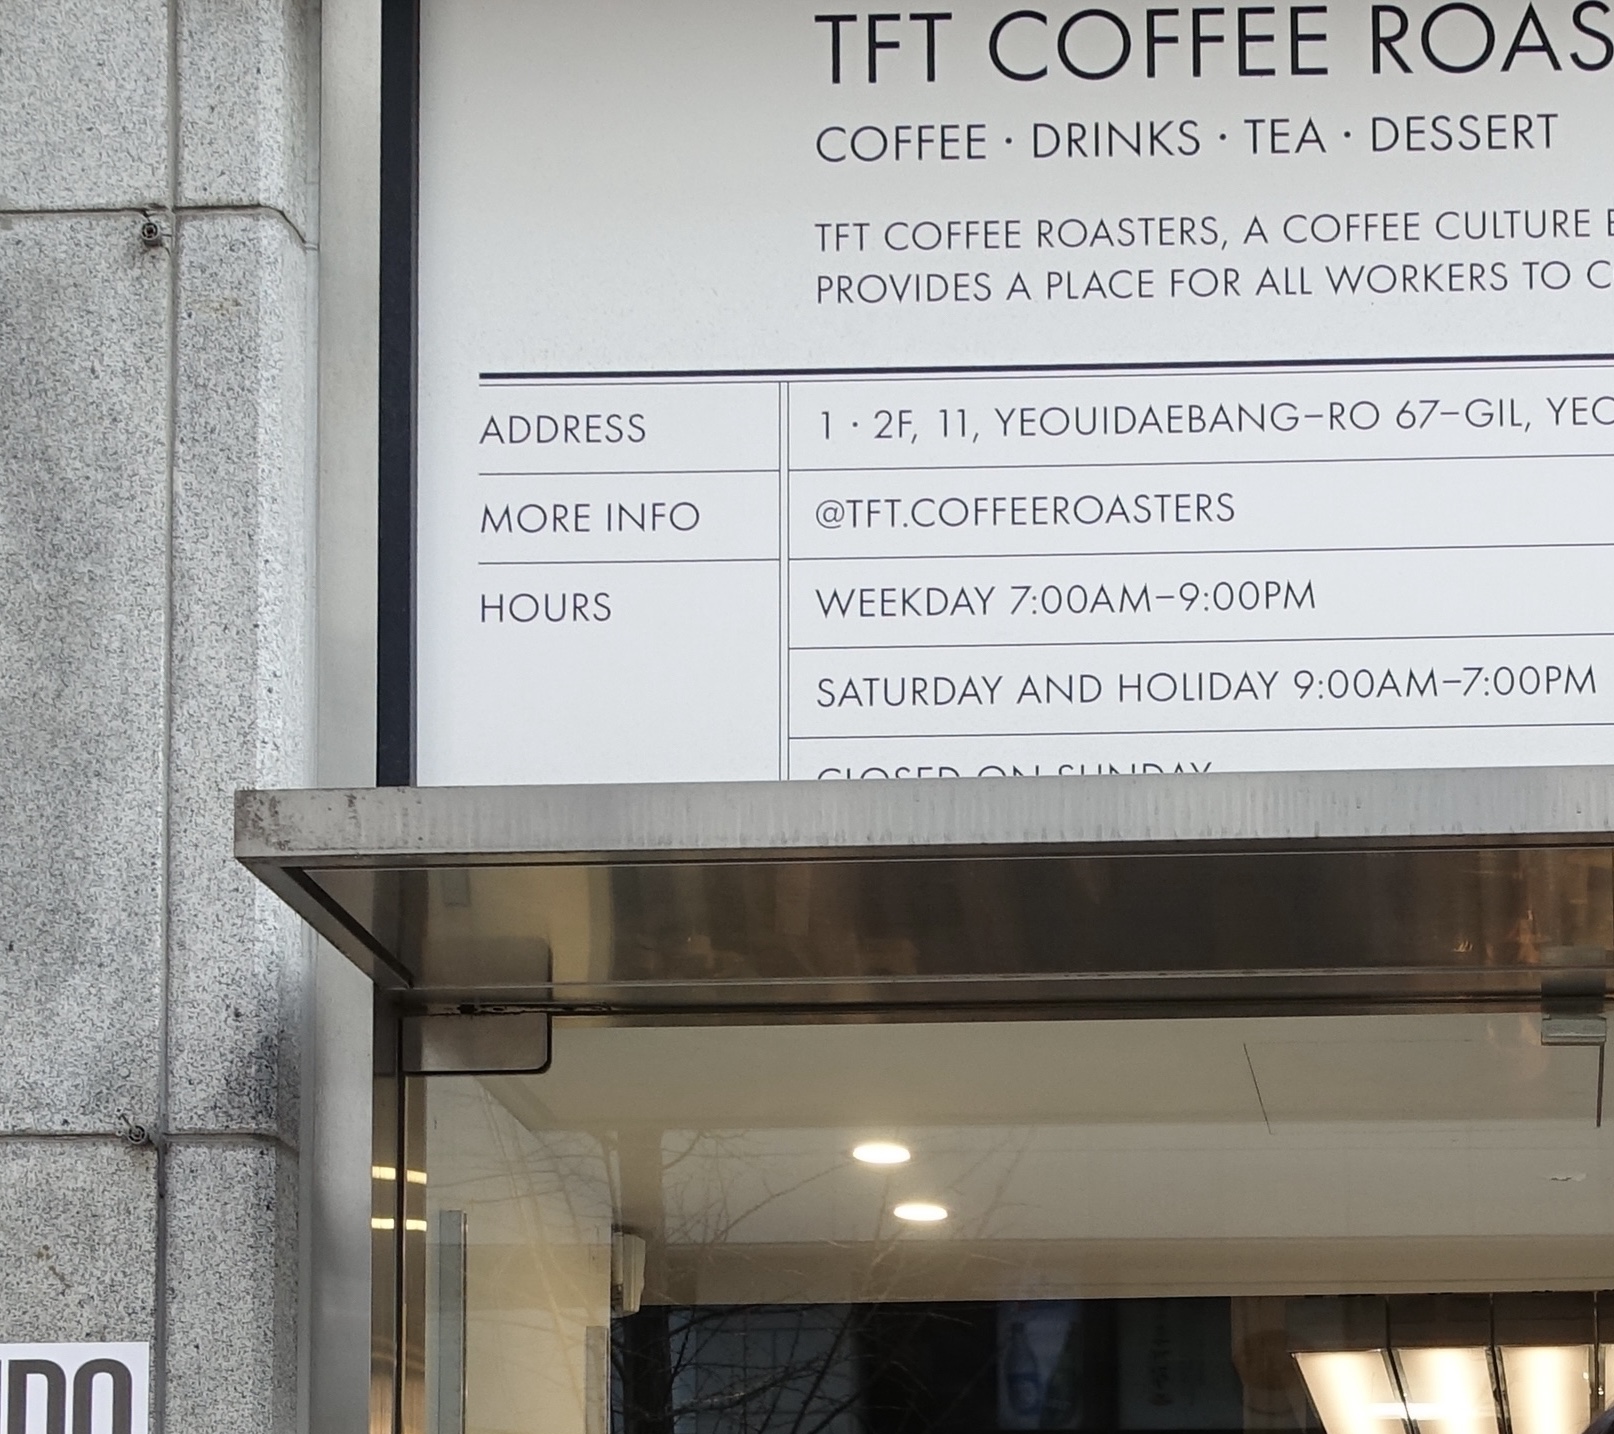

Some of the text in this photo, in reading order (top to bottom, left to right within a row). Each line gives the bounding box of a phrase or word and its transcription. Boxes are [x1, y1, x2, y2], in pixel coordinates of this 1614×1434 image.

[814, 12, 952, 84] TFT
[989, 5, 1328, 81] COFFEE
[816, 124, 986, 162] COFFEE
[1033, 120, 1200, 158] DRINKS
[1244, 117, 1326, 154] TEA
[1372, 114, 1558, 152] DESSERT
[814, 223, 870, 252] TFT
[885, 220, 1021, 251] COFFEE
[1038, 216, 1227, 250] ROASTERS,
[1243, 216, 1268, 244] A
[1283, 212, 1420, 243] COFFEE
[1436, 209, 1590, 240] CULTURE
[818, 272, 991, 304] PROVIDES
[1006, 272, 1031, 300] A
[1048, 270, 1154, 300] PLACE
[1171, 268, 1240, 297] FOR
[1255, 267, 1312, 296] ALL
[1325, 262, 1508, 295] WORKERS
[1522, 261, 1570, 290] TO
[479, 414, 645, 444] ADDRESS
[822, 411, 829, 439] 1
[874, 410, 917, 444] 2F,
[939, 409, 978, 443] 11,
[481, 502, 699, 533] MORE INFO
[816, 493, 1234, 529] @TFT.COFFEEROASTERS
[481, 592, 611, 622] HOURS
[815, 586, 995, 618] WEEKDAY
[817, 676, 1003, 707] SATURDAY
[1016, 674, 1102, 704] AND
[1119, 671, 1279, 702] HOLIDAY
